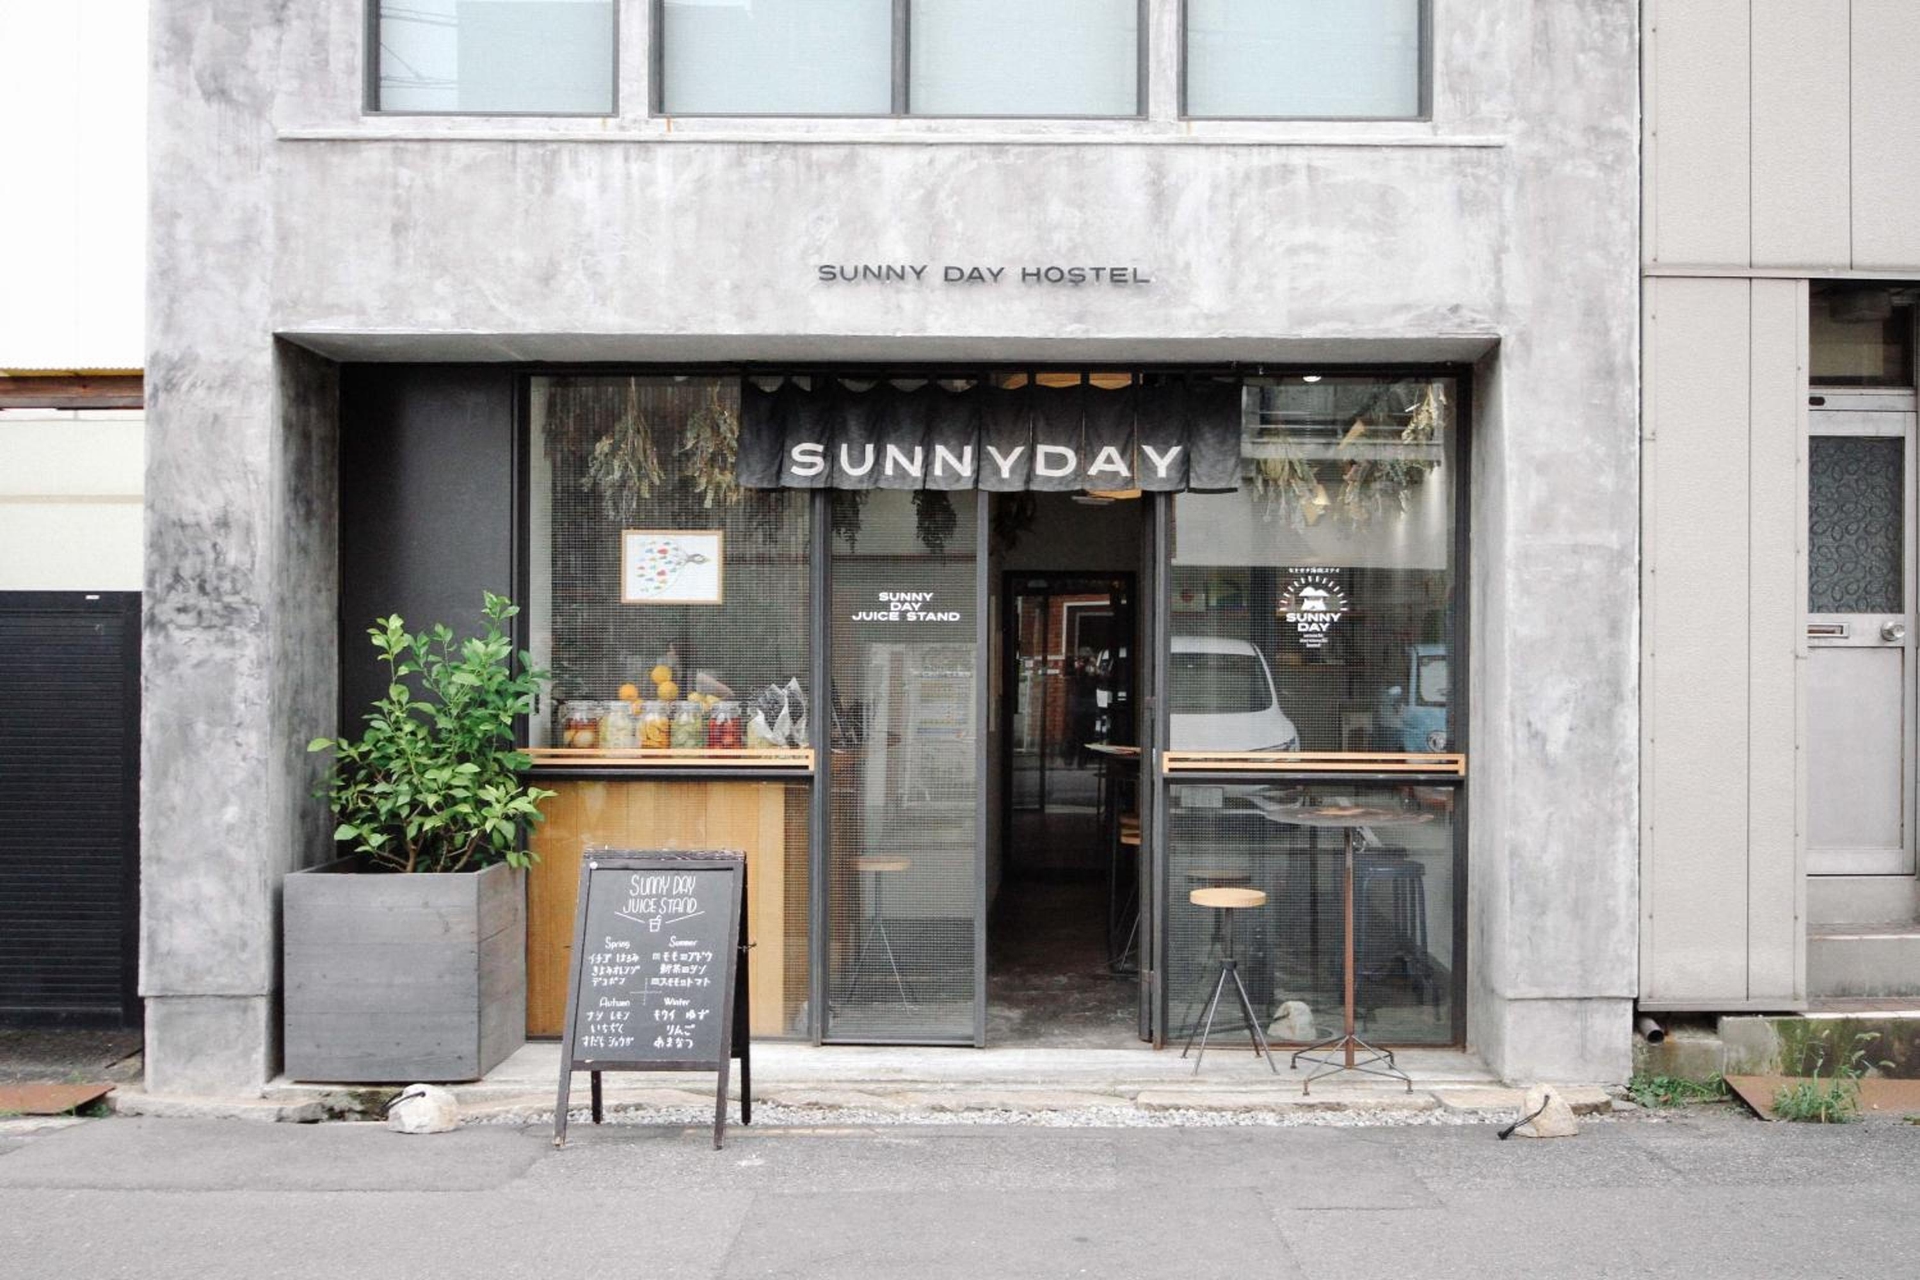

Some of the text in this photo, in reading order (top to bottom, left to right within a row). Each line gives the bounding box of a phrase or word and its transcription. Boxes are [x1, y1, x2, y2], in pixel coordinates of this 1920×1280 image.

[818, 264, 1151, 284] SUNNY DAY HOSTEL
[790, 442, 1183, 479] SUNNYDAY
[878, 592, 934, 602] SUNNY
[890, 602, 922, 611] DAY
[851, 611, 961, 622] JUICE STAND
[1285, 613, 1342, 623] SUNNY
[1297, 623, 1331, 632] DAY
[672, 875, 696, 895] DAY
[622, 897, 698, 914] JUICE STAND
[604, 936, 631, 951] Spring
[668, 935, 698, 948] Summer
[663, 996, 691, 1007] Winter
[666, 1024, 696, 1036] りんご
